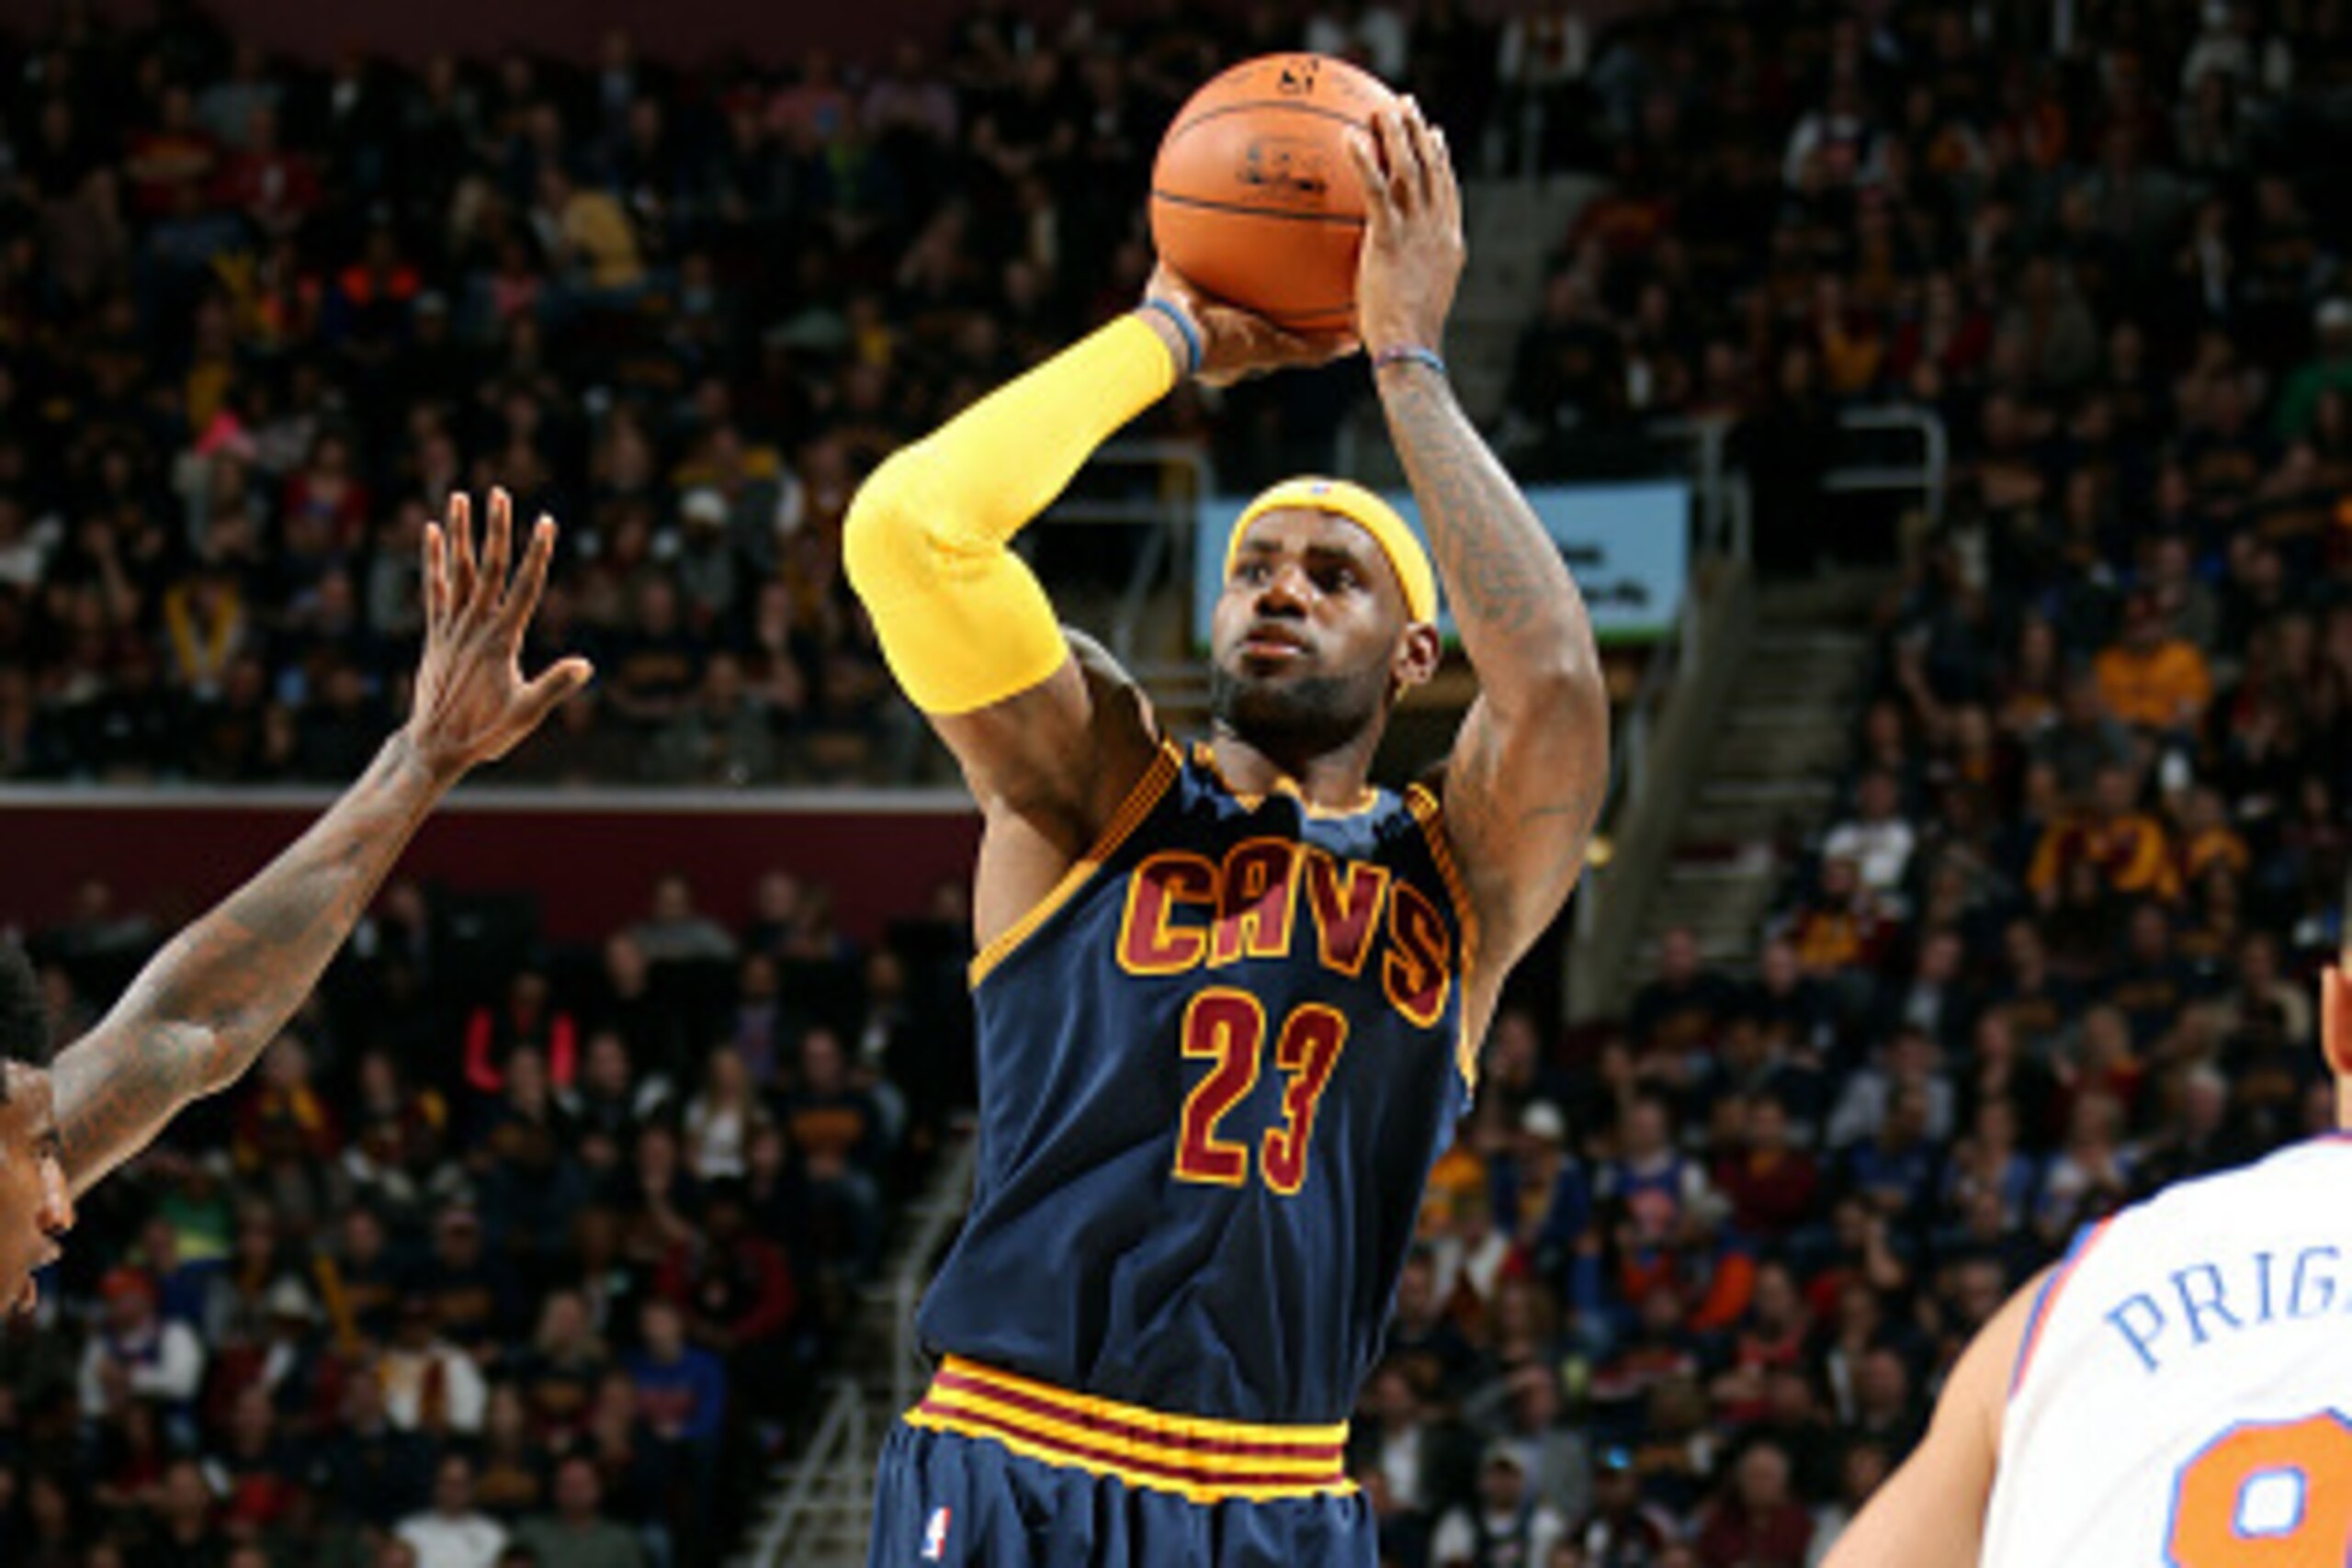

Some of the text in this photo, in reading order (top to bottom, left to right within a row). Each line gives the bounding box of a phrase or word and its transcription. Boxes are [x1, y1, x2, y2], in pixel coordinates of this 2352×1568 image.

[1116, 836, 1450, 1028] CAVS
[1171, 986, 1349, 1194] 23
[2104, 1245, 2352, 1372] PRIG
